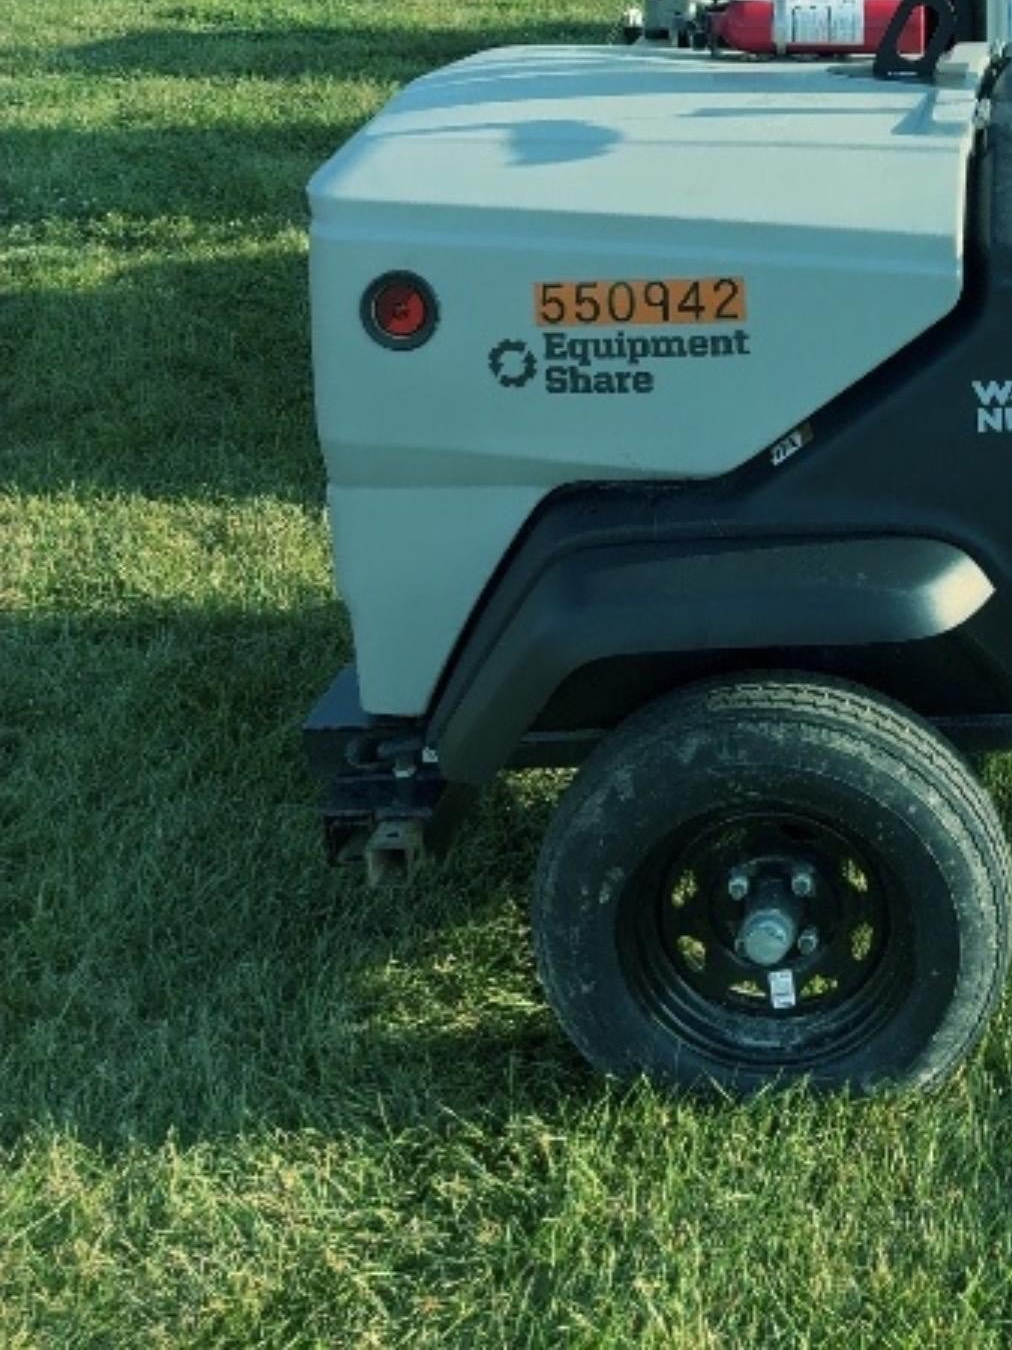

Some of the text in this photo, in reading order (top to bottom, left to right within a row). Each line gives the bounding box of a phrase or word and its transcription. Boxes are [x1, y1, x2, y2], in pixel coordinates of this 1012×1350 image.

[540, 277, 740, 324] 550942
[542, 329, 751, 367] Equipment
[544, 365, 655, 395] Share
